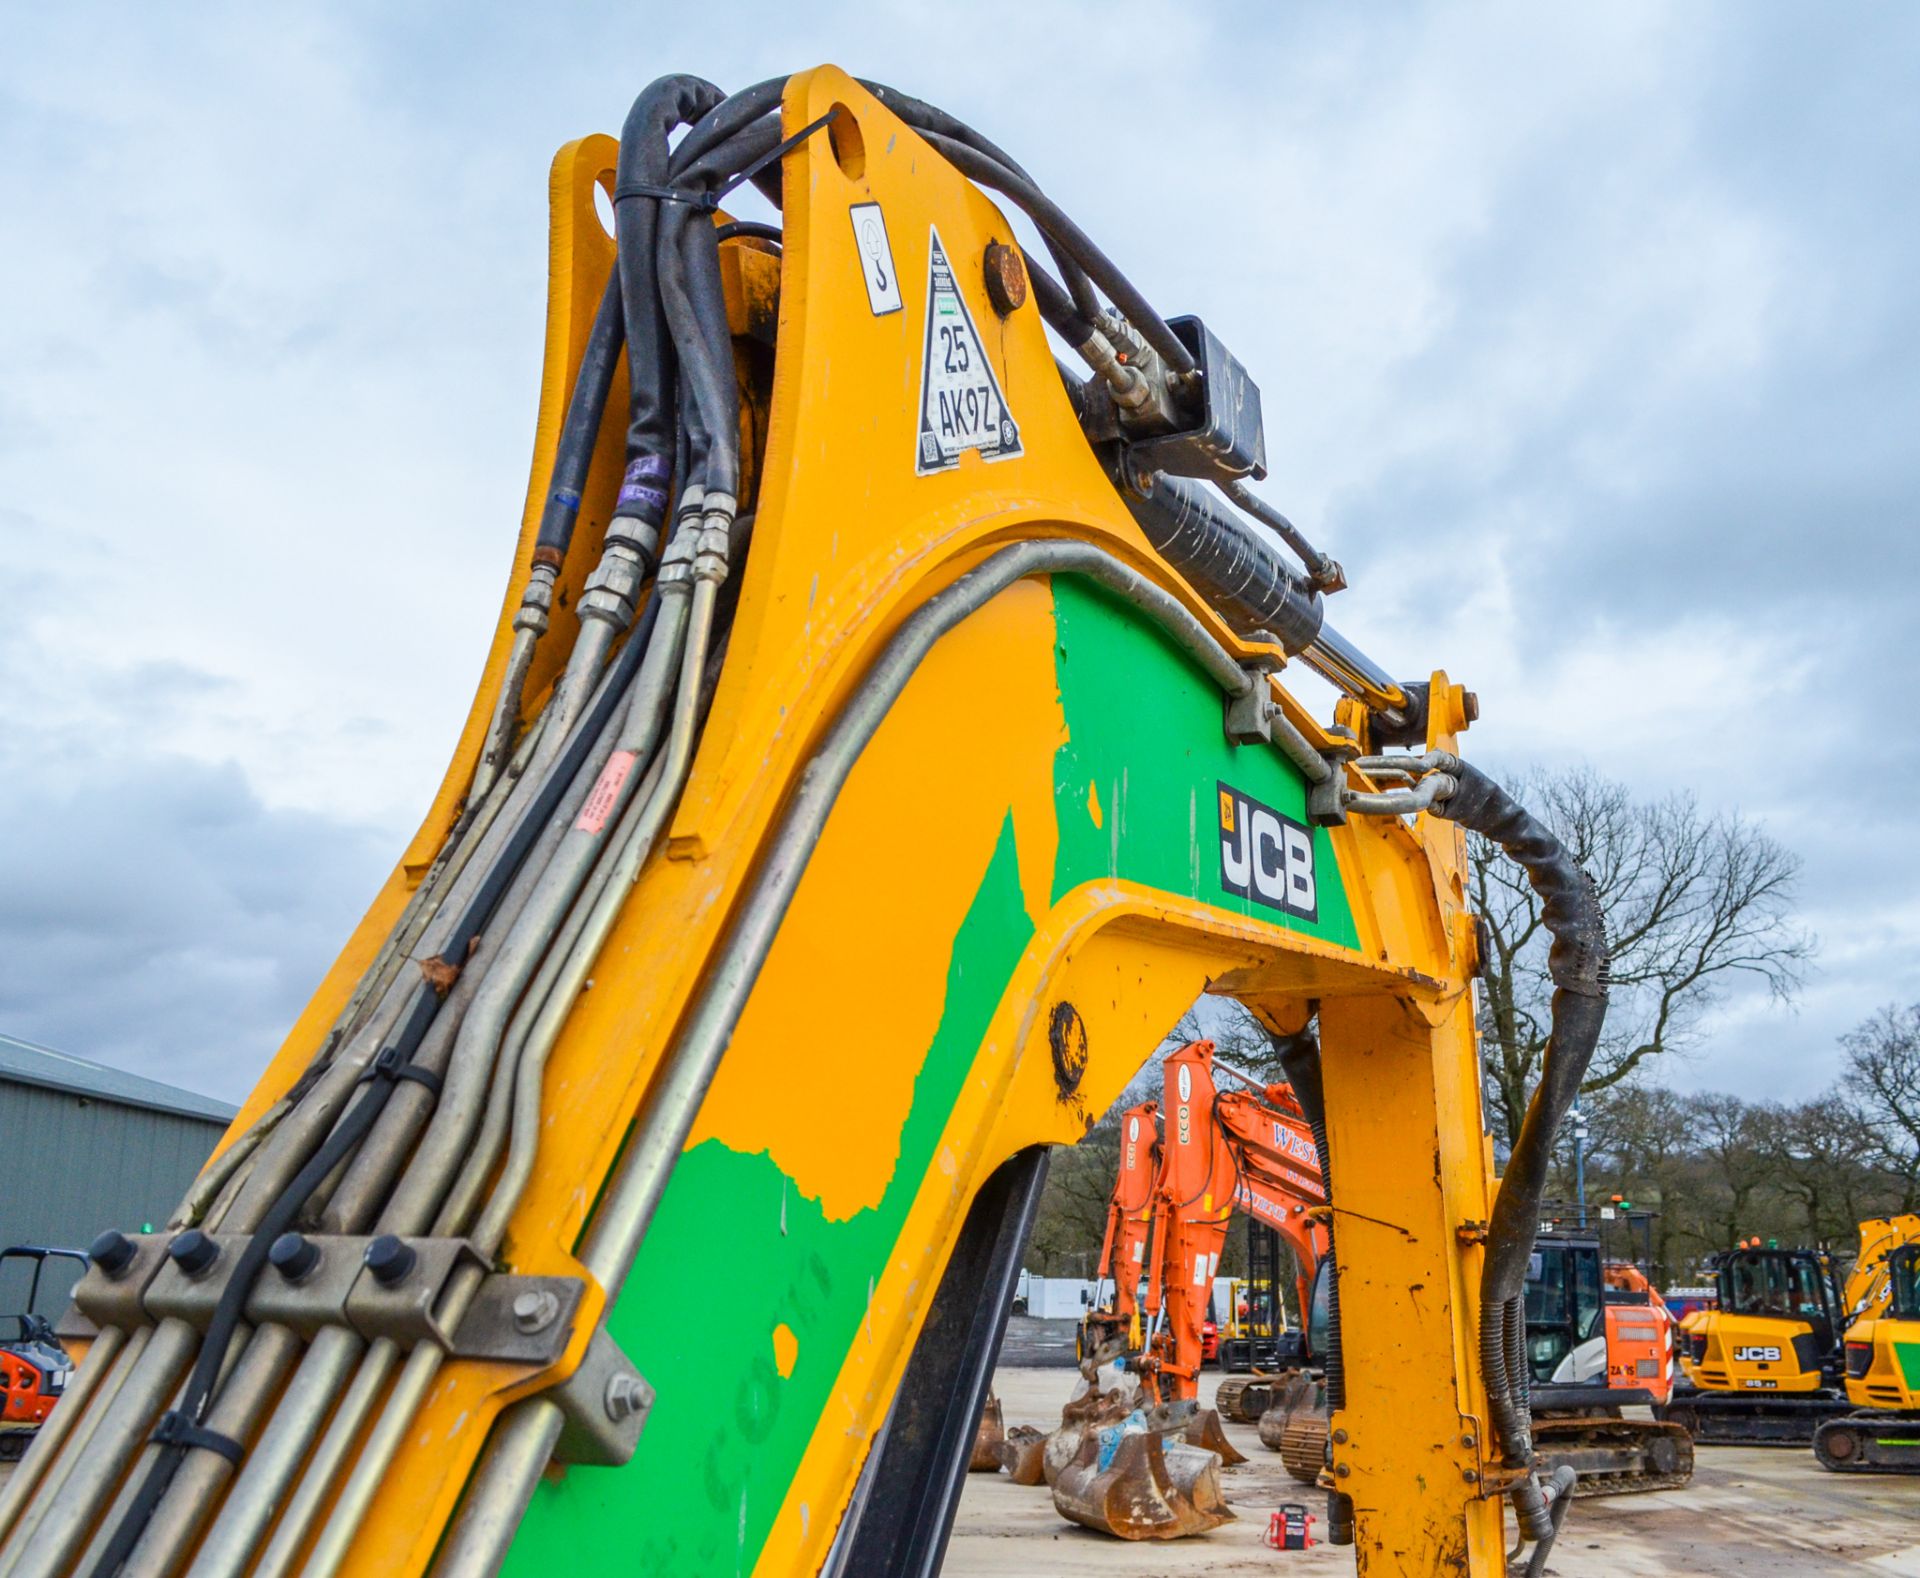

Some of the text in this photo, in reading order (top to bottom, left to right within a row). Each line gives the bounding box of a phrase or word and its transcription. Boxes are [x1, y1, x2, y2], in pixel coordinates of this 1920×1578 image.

[940, 326, 970, 374] 25
[939, 386, 997, 438] AK9Z
[1223, 800, 1315, 912] JCB
[1180, 1107, 1189, 1144] eco
[1734, 1347, 1780, 1360] JCB
